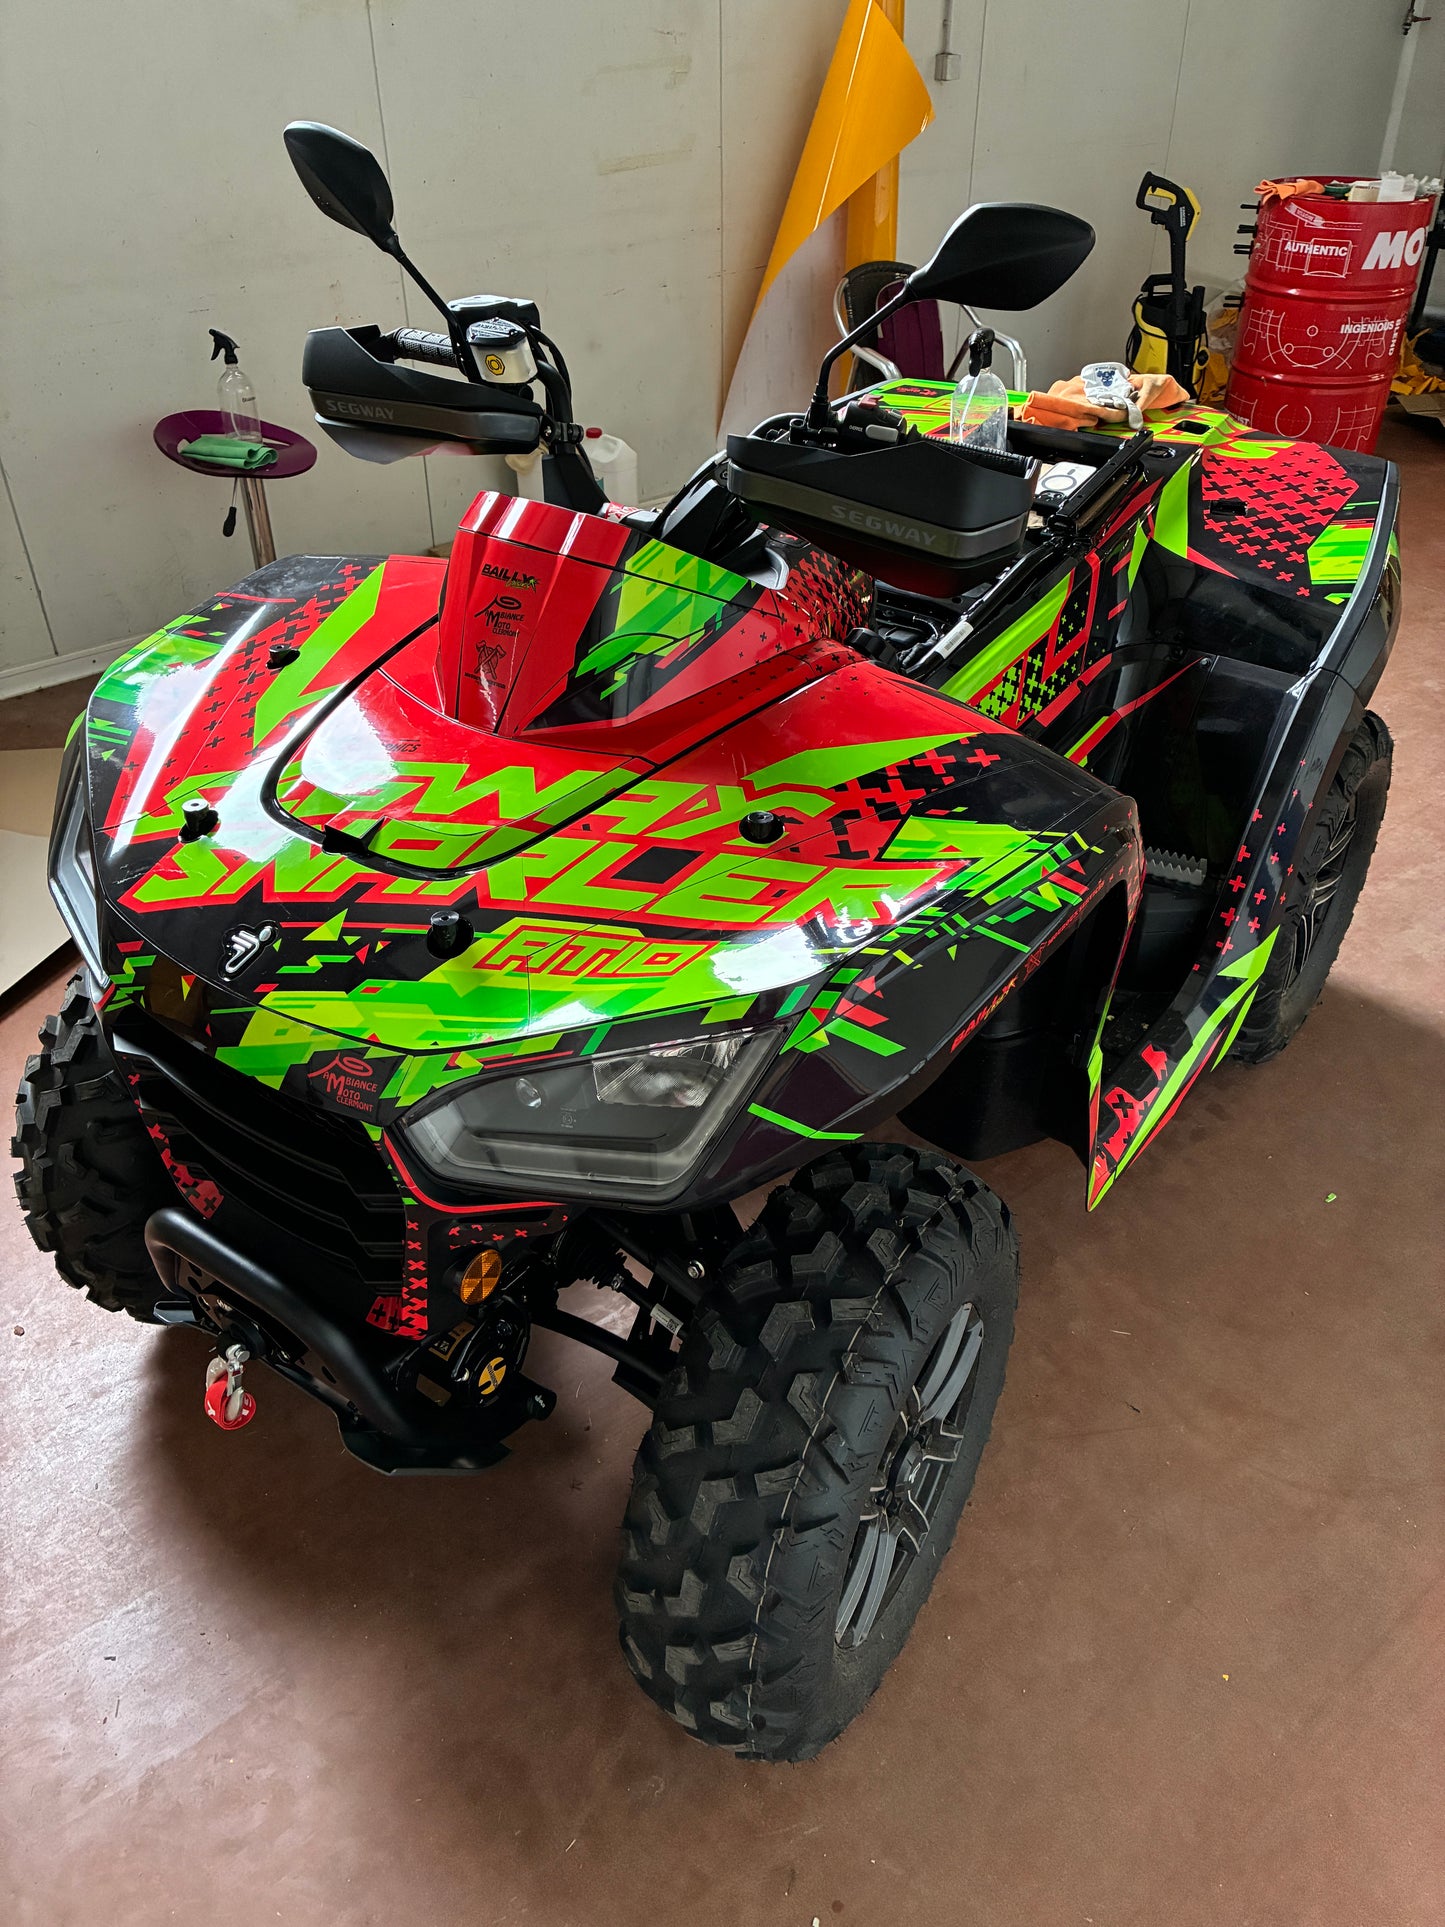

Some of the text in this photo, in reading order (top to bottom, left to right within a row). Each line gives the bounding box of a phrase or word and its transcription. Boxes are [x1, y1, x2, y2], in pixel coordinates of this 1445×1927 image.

[1285, 241, 1348, 257] AUTHENTIC
[1361, 227, 1427, 270] MO
[1340, 320, 1395, 334] INGENIOUS
[326, 400, 395, 420] SEGWAY
[832, 505, 937, 545] SEGWAY
[481, 563, 536, 588] BAILLY
[130, 817, 943, 924] SNARLER
[322, 1071, 378, 1096] AMBIANCE
[336, 1095, 374, 1112] CLERMONT
